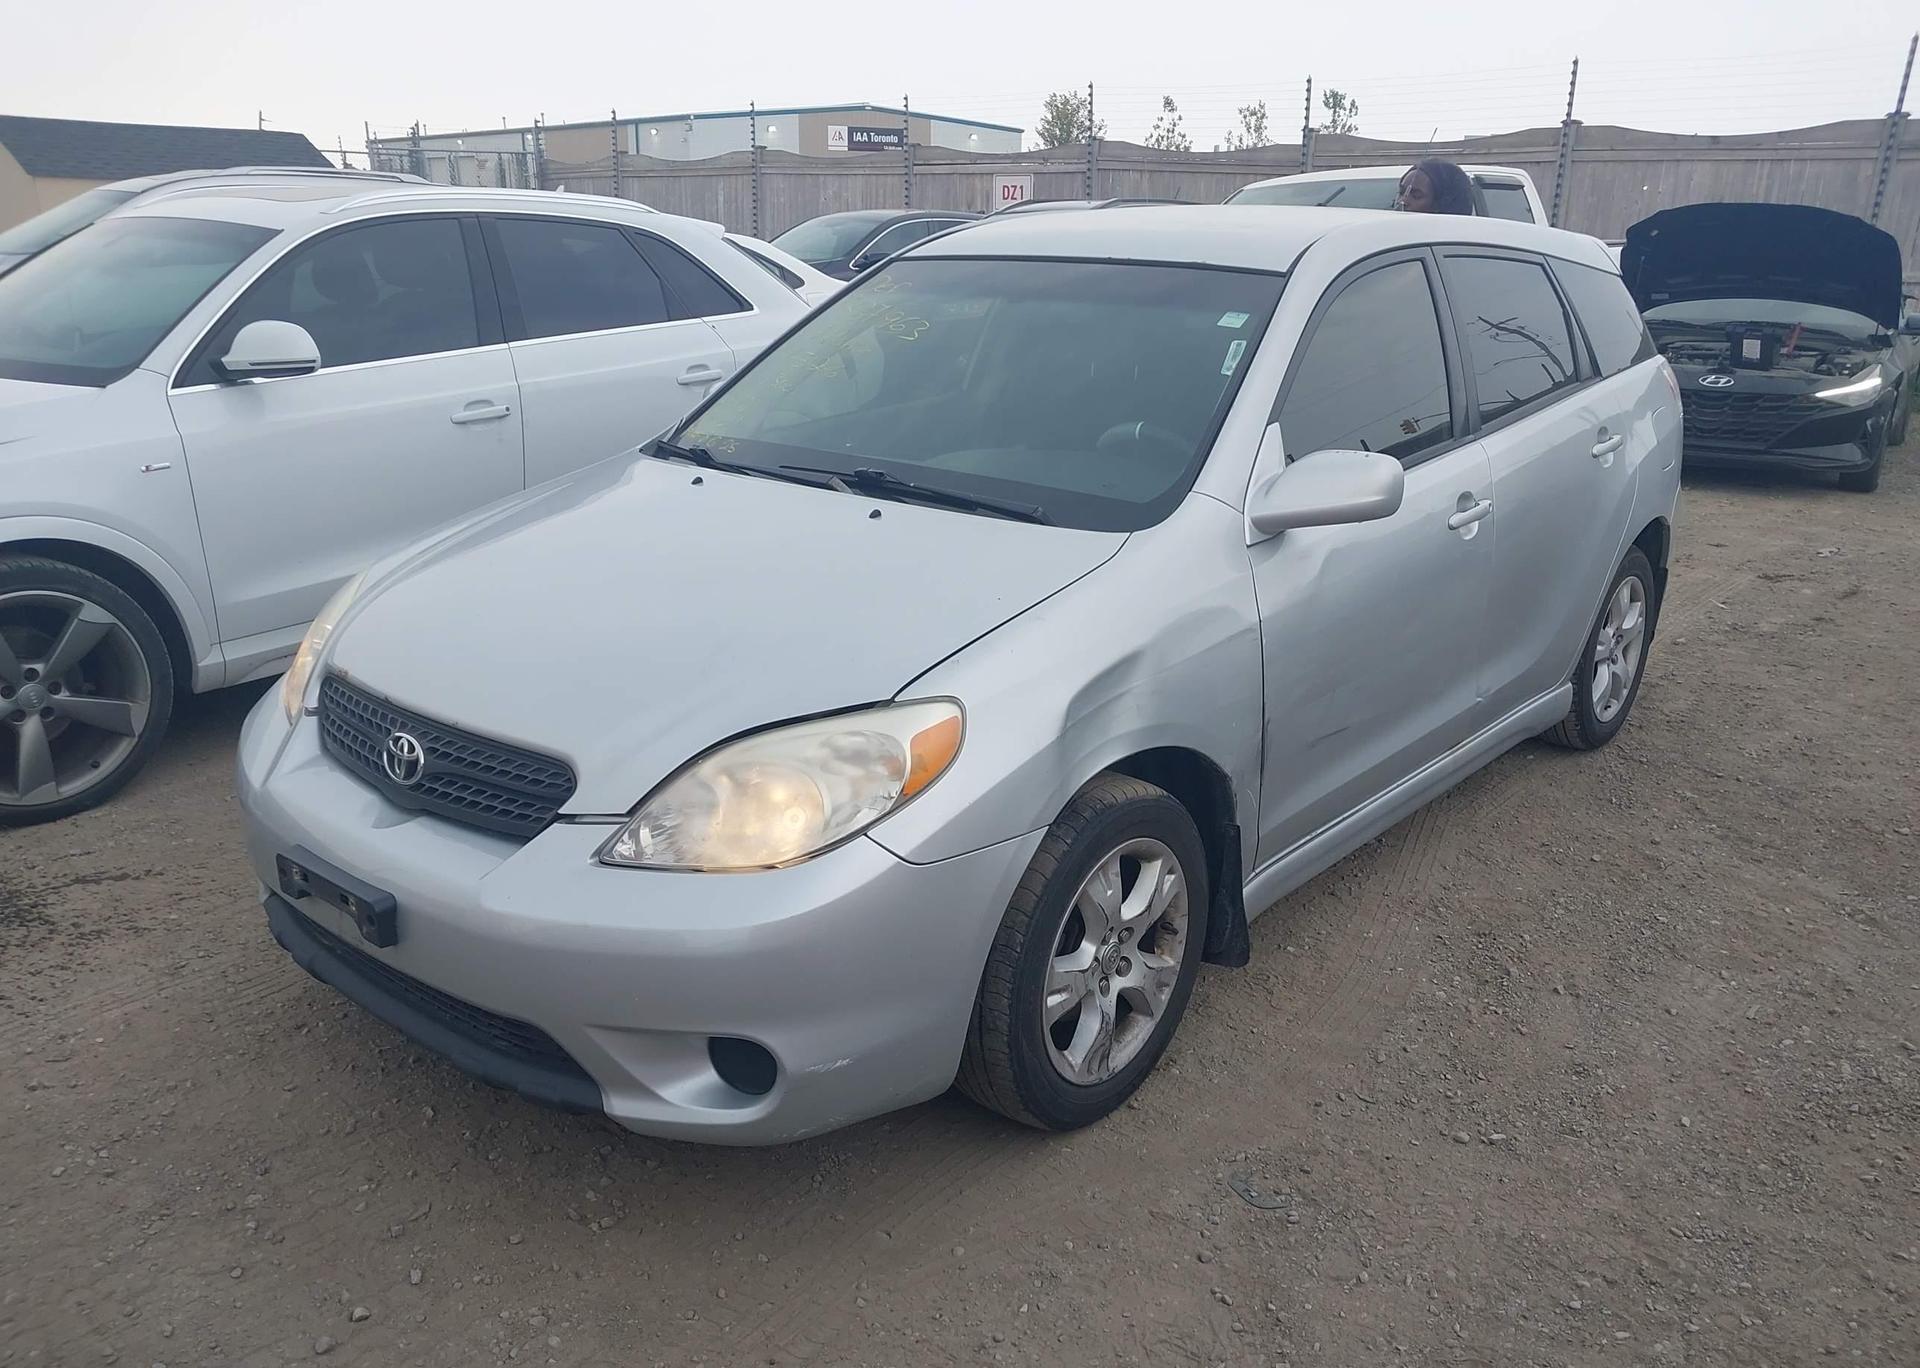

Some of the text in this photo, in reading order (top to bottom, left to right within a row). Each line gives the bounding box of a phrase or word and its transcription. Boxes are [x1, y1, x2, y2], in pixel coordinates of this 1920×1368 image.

[853, 131, 898, 143] IAA Toronto
[1002, 184, 1024, 200] DZ1
